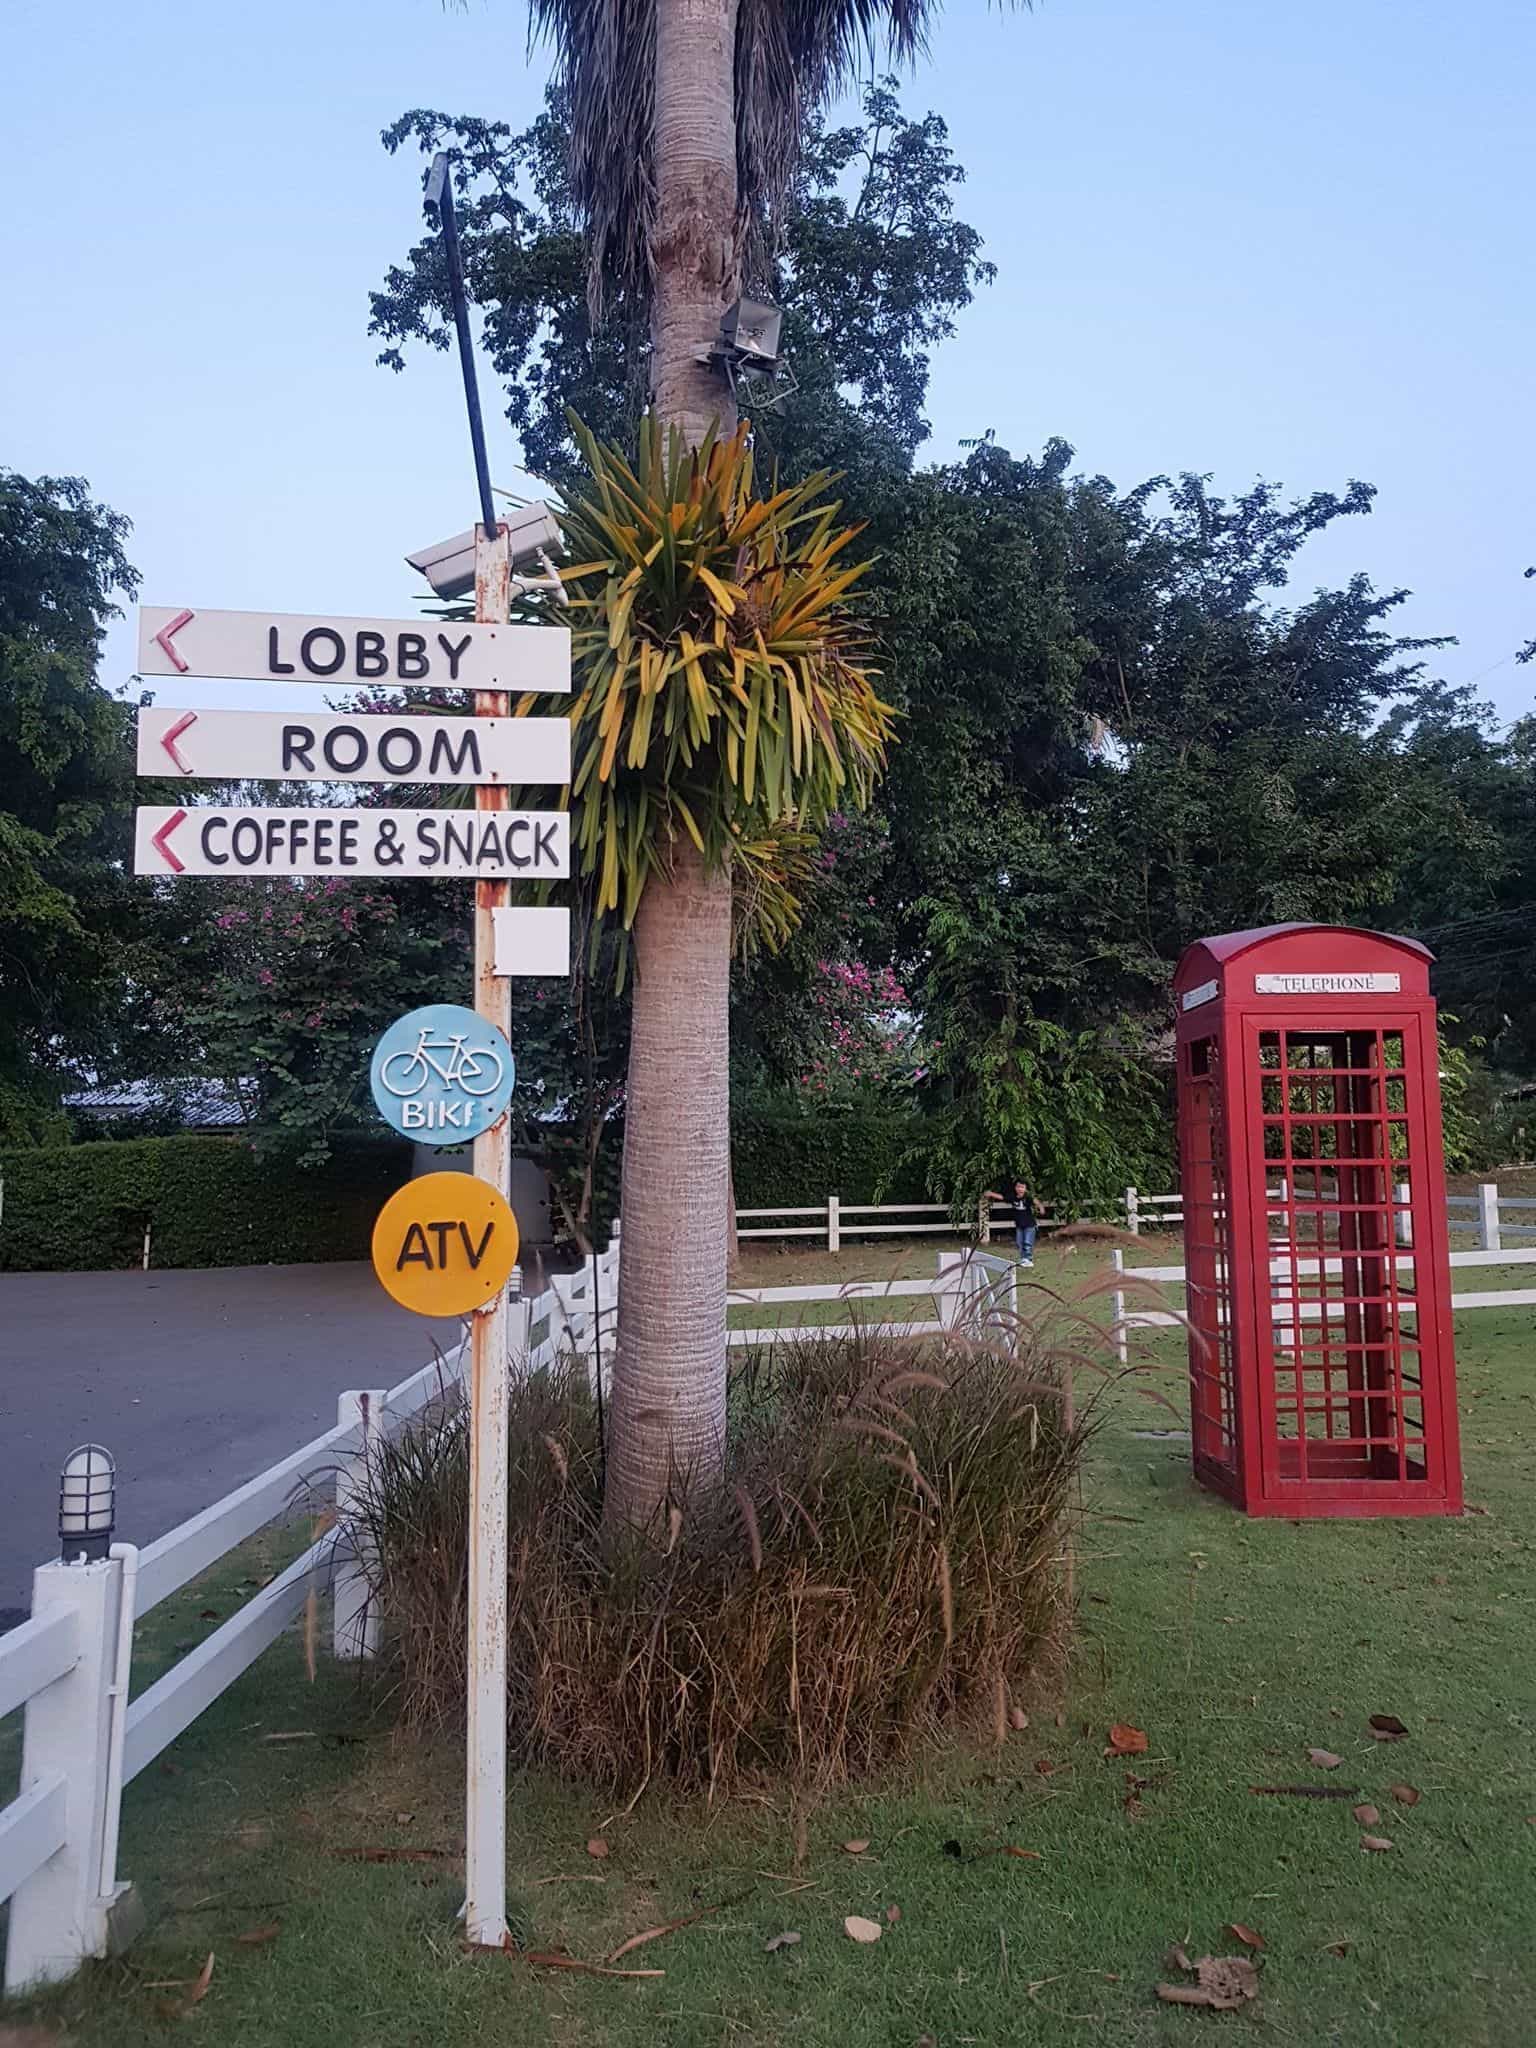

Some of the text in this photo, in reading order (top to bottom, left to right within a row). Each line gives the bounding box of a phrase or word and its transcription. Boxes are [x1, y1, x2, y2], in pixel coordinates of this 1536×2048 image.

[269, 626, 472, 680] LOBBY
[283, 726, 481, 775] ROOM
[201, 817, 559, 867] COFFEE & SNACK
[1281, 976, 1376, 991] TELEPHONE
[397, 1222, 494, 1272] ATV
